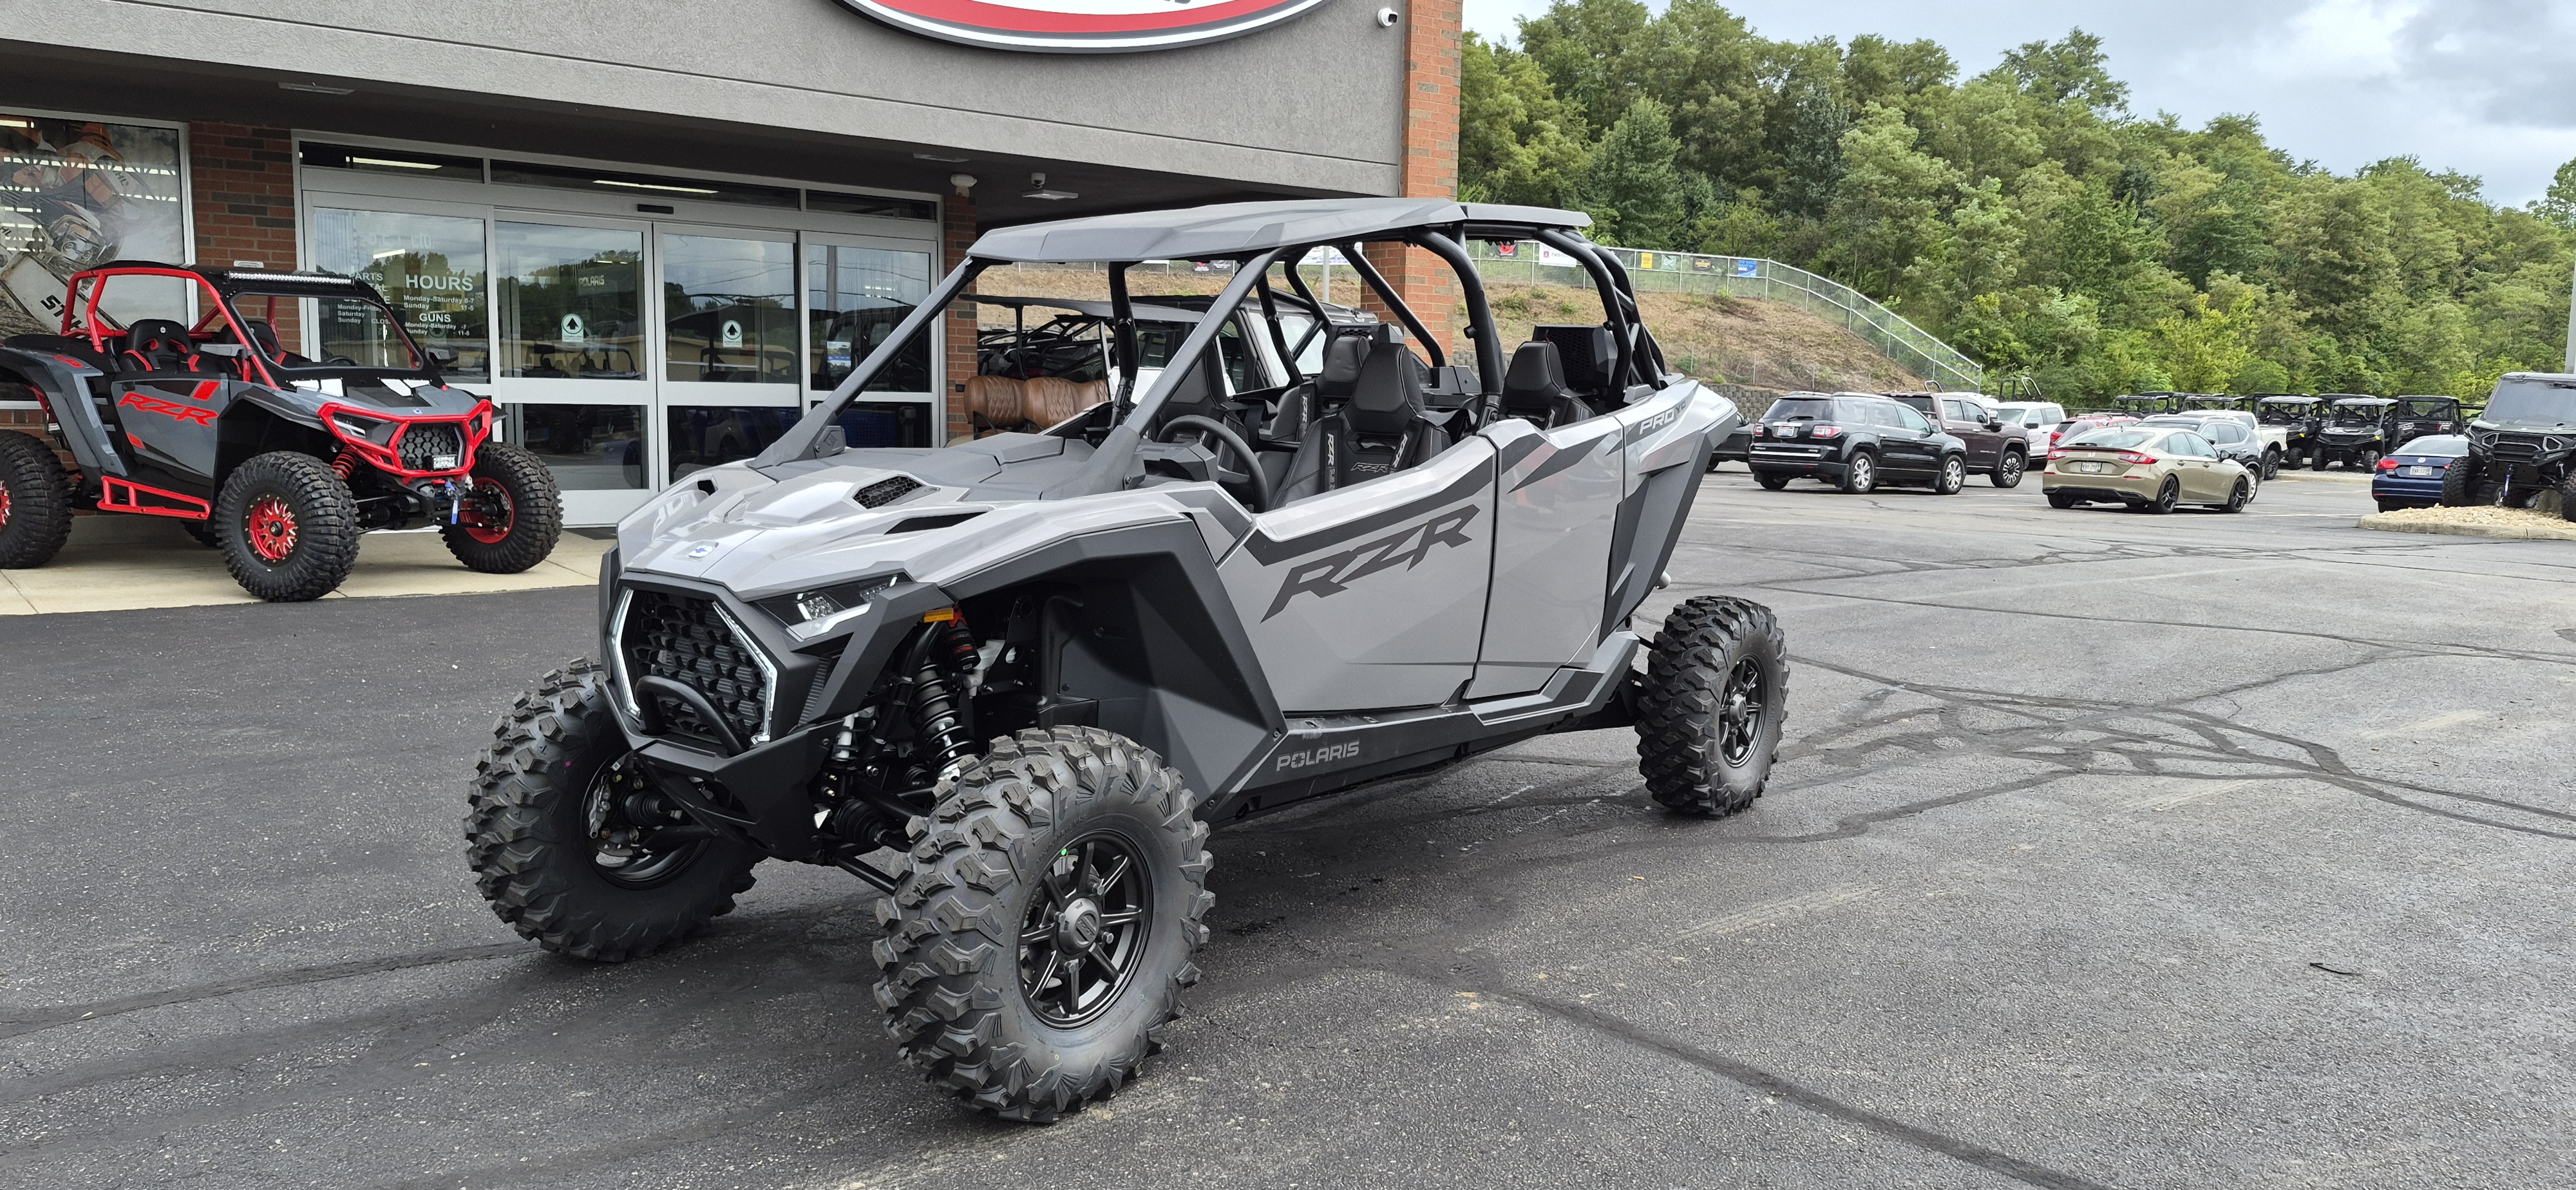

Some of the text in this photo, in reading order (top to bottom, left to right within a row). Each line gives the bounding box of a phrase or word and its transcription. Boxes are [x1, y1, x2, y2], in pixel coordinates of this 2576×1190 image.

[406, 274, 473, 291] HOURS
[579, 275, 605, 286] POLARIS
[403, 295, 462, 304] Monday-Saturday
[419, 313, 451, 322] GUNS
[117, 392, 219, 426] RZR
[1639, 409, 1674, 435] PRO
[1392, 433, 1408, 468] RZR
[1350, 462, 1390, 473] RZR
[1260, 504, 1481, 623] RZR
[1276, 741, 1360, 771] POLARIS
